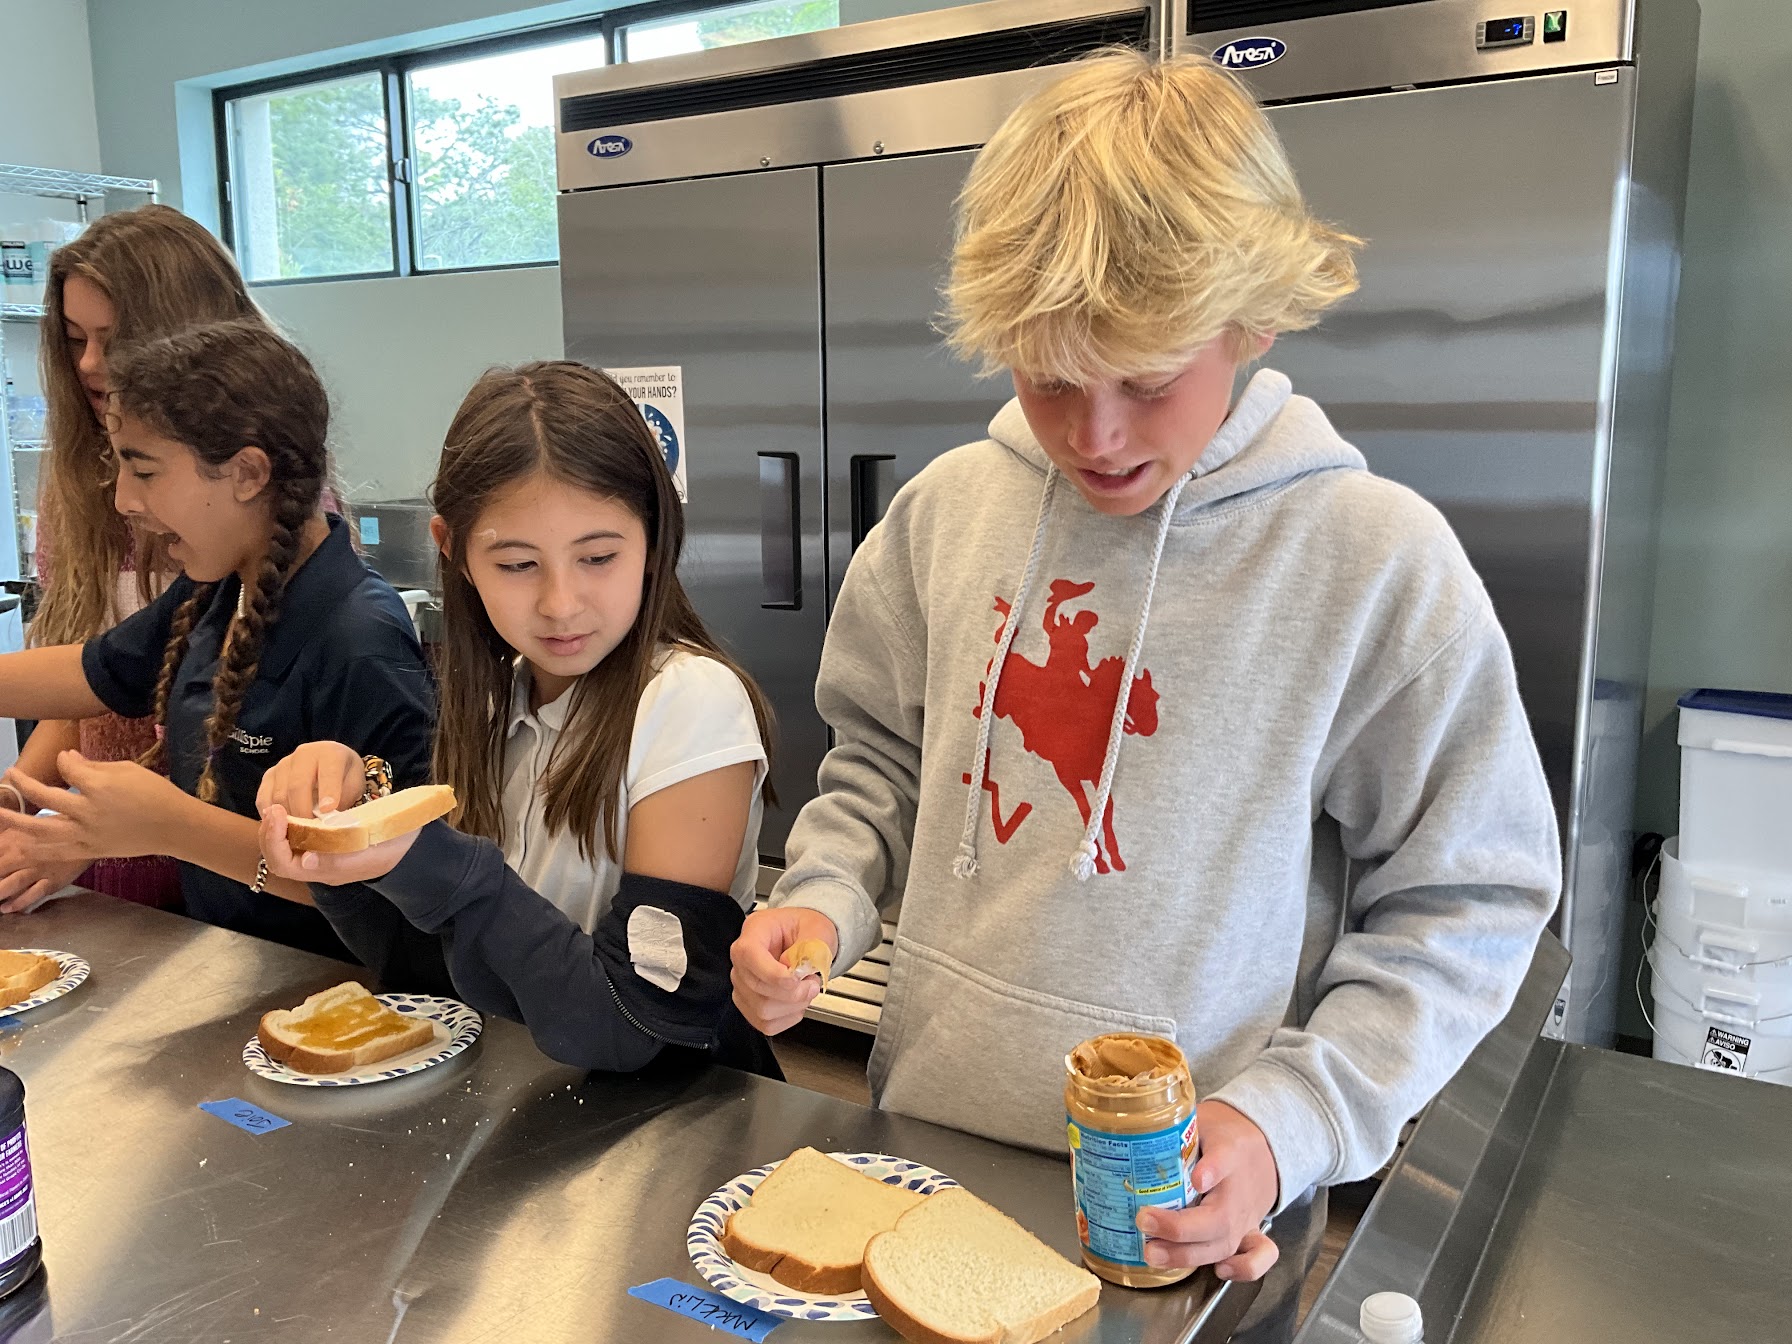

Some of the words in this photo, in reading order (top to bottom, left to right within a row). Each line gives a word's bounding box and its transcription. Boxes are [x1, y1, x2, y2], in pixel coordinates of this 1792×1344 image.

[619, 375, 633, 386] you
[633, 373, 665, 383] remember
[667, 372, 676, 382] to
[629, 386, 646, 399] YOUR
[647, 385, 677, 399] HANDS?
[1715, 1038, 1736, 1051] AVISO
[1717, 1030, 1749, 1047] WARNING
[1108, 1140, 1128, 1148] Facts
